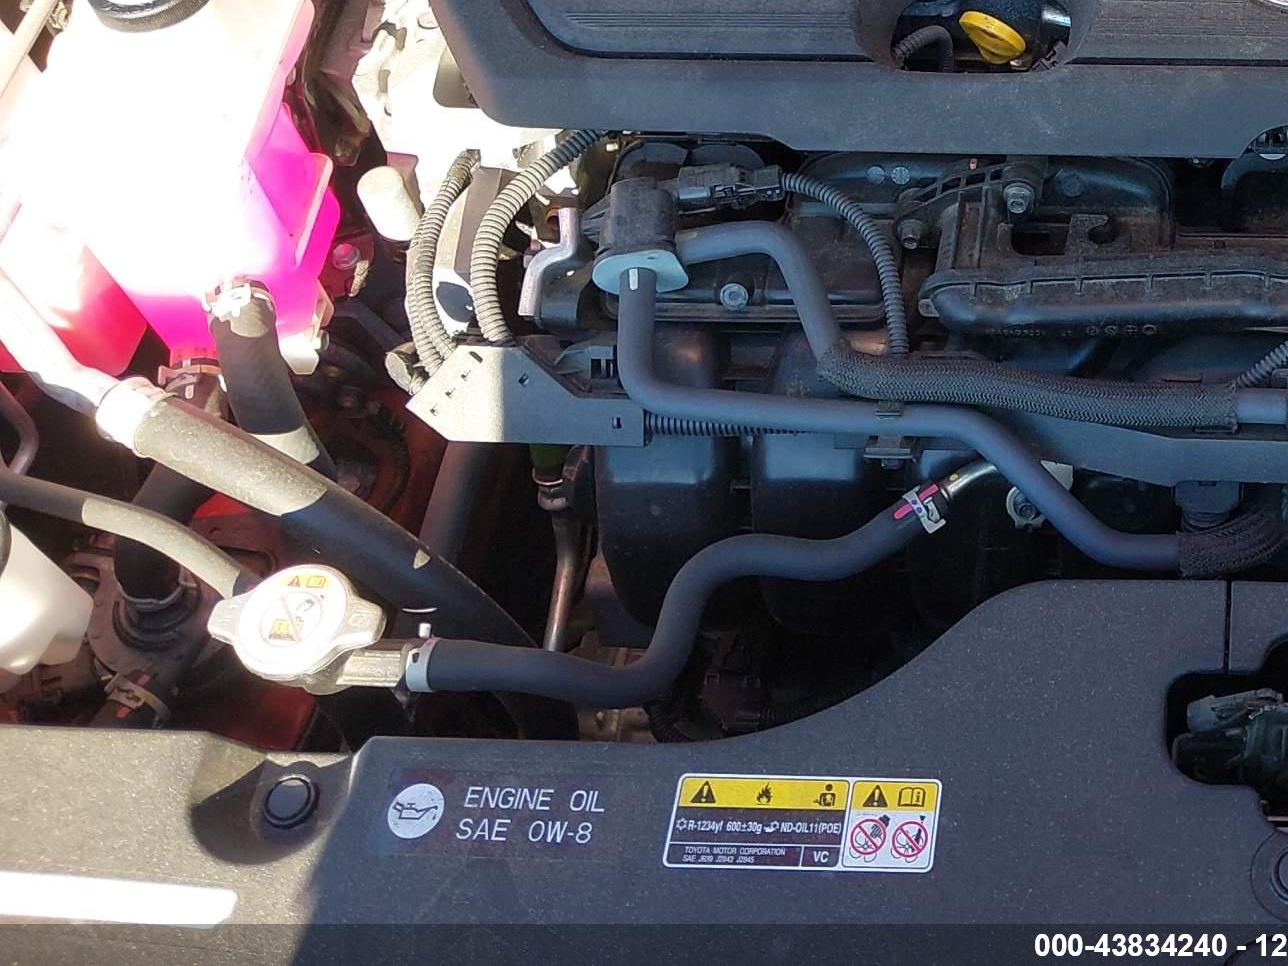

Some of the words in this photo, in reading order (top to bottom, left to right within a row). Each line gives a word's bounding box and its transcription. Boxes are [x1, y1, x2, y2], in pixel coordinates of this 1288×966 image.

[463, 786, 555, 811] ENGINE
[569, 789, 606, 813] OIL
[455, 817, 512, 841] SAE
[527, 820, 593, 845] 0W-8
[687, 819, 724, 834] R-1234yf
[726, 820, 762, 835] 600±30g
[780, 822, 842, 835] ND-OIL11(POE)
[685, 846, 711, 855] TOYOTA
[713, 846, 737, 855] MOTOR
[739, 847, 786, 856] CORPORATION
[811, 850, 830, 863] VC
[682, 854, 697, 863] SAE
